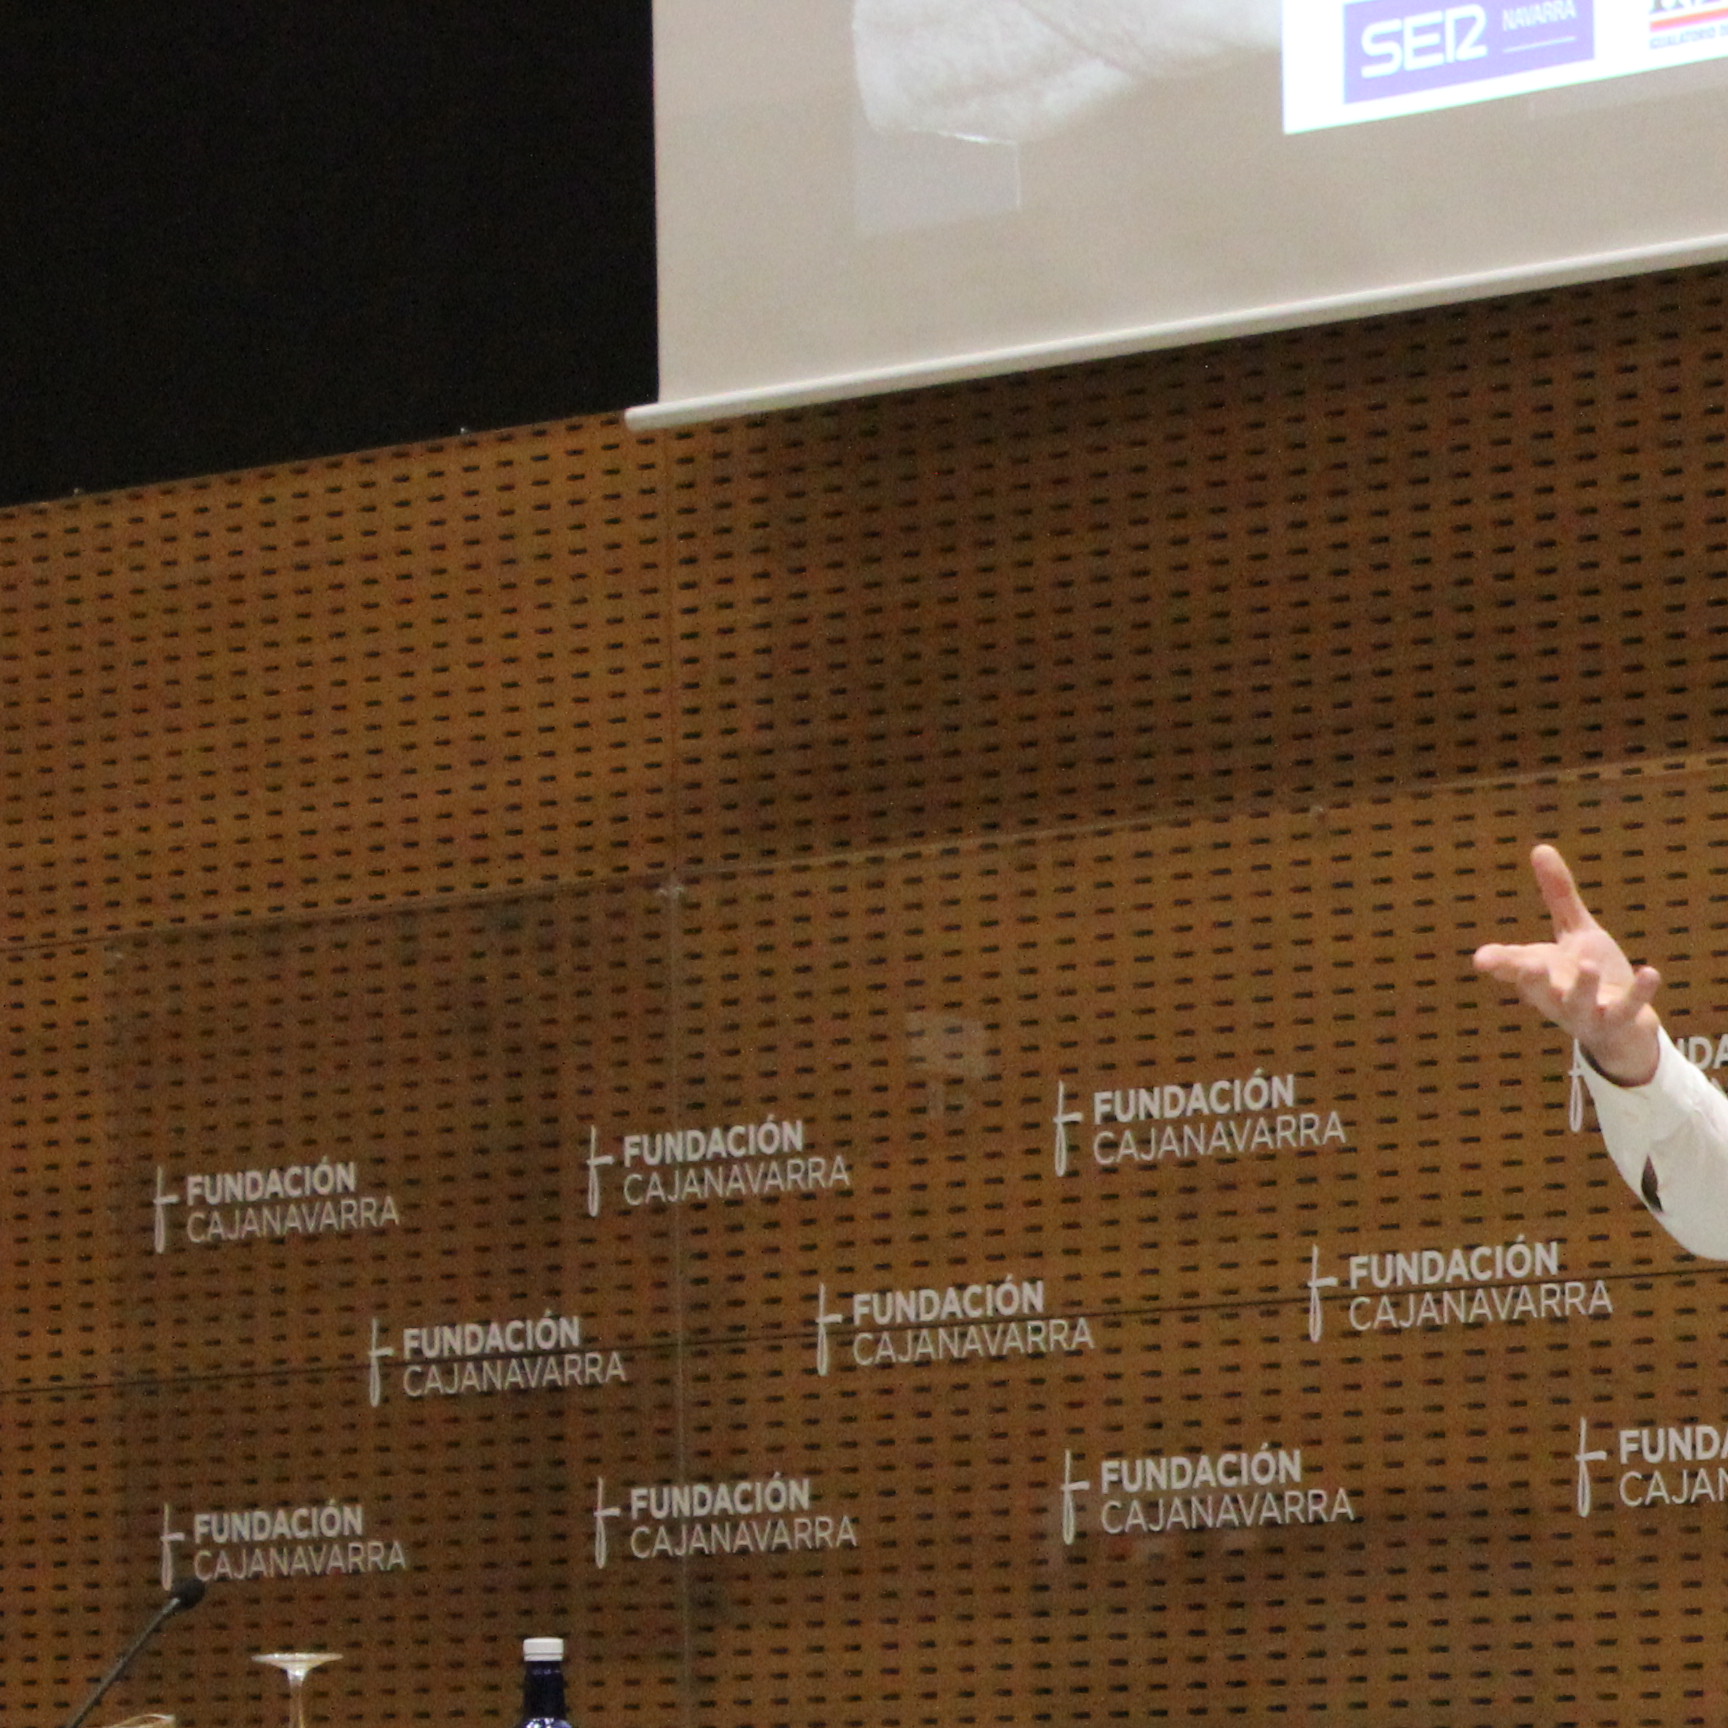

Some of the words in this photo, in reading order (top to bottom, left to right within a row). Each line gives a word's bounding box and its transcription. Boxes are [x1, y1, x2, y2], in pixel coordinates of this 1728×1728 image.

[1502, 0, 1577, 31] NAVARRA
[1361, 4, 1488, 78] SER
[1094, 1068, 1294, 1124] FUNDACIÓN
[624, 1115, 803, 1167] FUNDACIÓN
[1094, 1111, 1345, 1164] CAJANAVARRA
[187, 1157, 356, 1205] FUNDACIÓN
[624, 1156, 849, 1205] CAJANAVARRA
[188, 1196, 398, 1242] CAJANAVARRA
[1350, 1235, 1558, 1289] FUNDACIÓN
[853, 1275, 1044, 1325] FUNDACIÓN
[1350, 1280, 1612, 1330] CAJANAVARRA
[404, 1310, 580, 1359] FUNDACIÓN
[854, 1318, 1094, 1365] CAJANAVARRA
[404, 1352, 625, 1396] CAJANAVARRA
[1102, 1443, 1300, 1493] FUNDACIÓN
[631, 1472, 809, 1519] FUNDACIÓN
[1102, 1488, 1353, 1533] CAJANAVARRA
[194, 1500, 362, 1543] FUNDACIÓN
[632, 1516, 856, 1558] CAJANAVARRA
[195, 1541, 405, 1581] CAJANAVARRA
